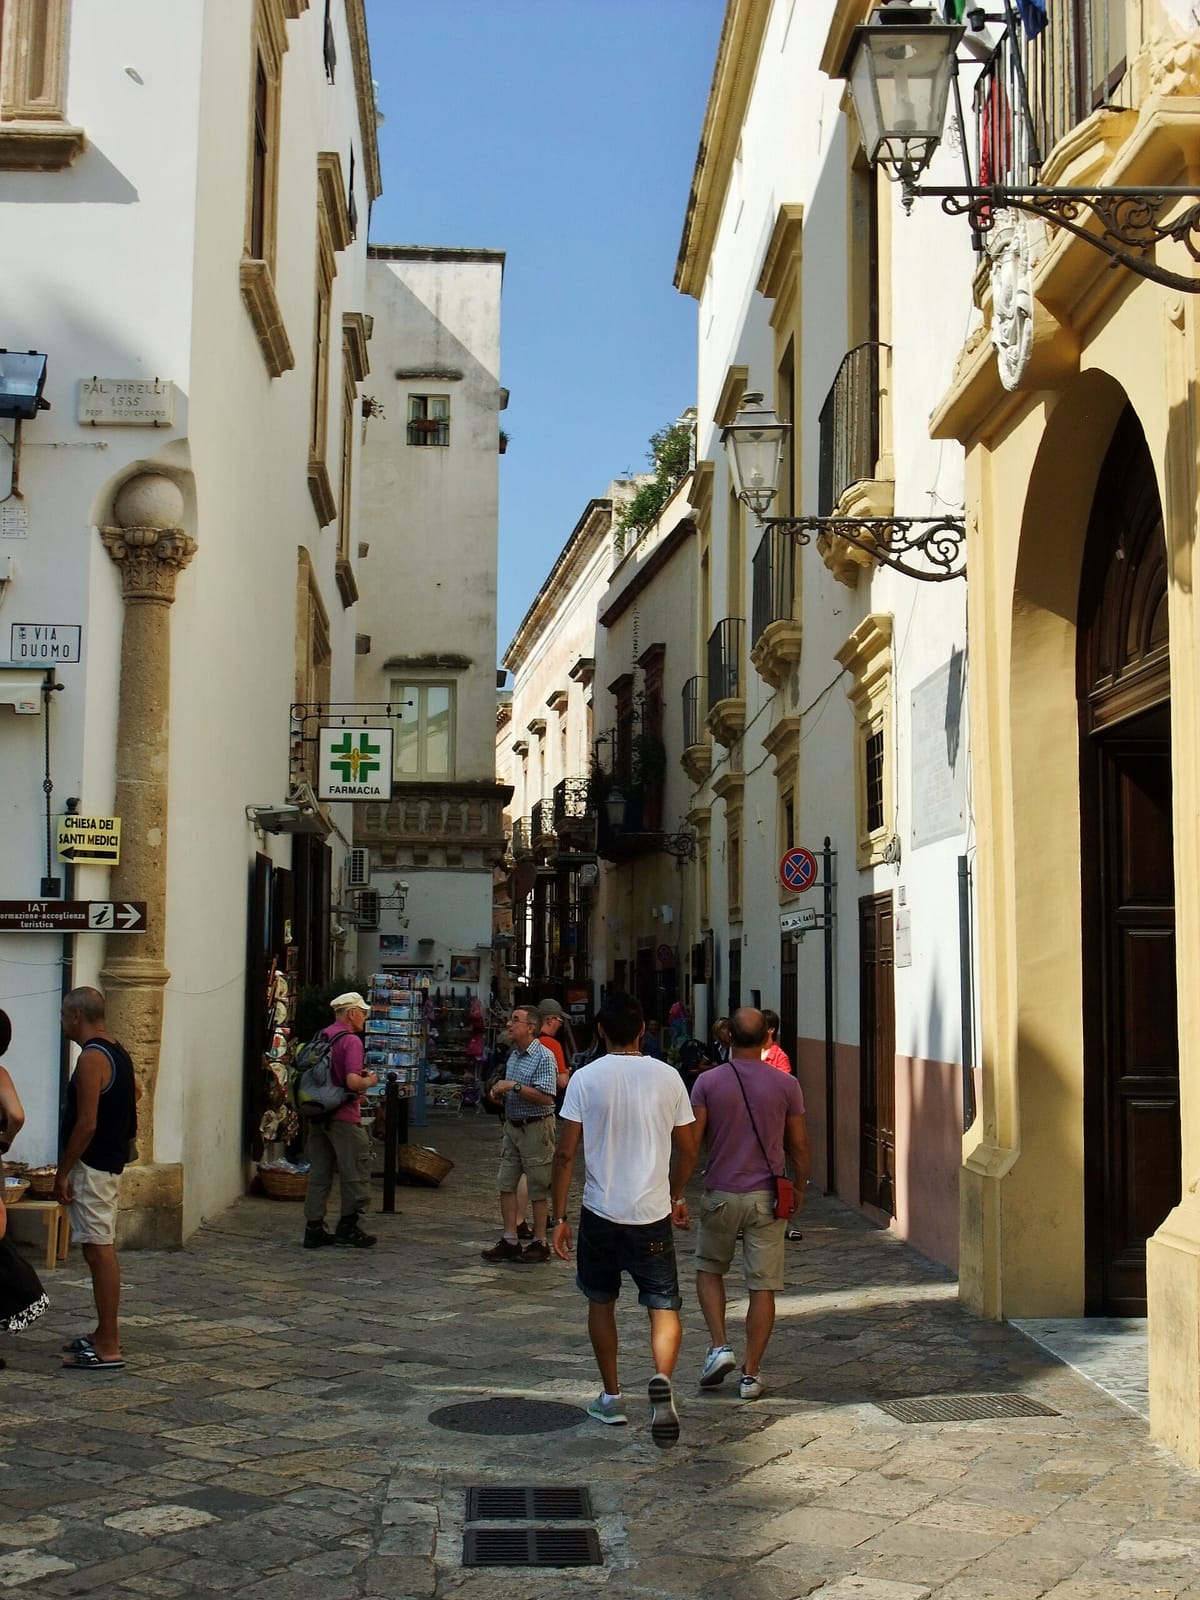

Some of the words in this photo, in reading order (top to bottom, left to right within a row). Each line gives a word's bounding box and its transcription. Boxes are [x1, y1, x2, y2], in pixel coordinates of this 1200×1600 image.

[115, 384, 167, 394] PIRELLI
[35, 627, 57, 640] VIA
[21, 644, 70, 657] DUOMO
[329, 785, 381, 795] FARMACIA
[64, 817, 97, 829] CHIESA
[98, 819, 114, 830] DEI
[58, 833, 86, 845] SANTI
[87, 834, 118, 847] MEDICI
[27, 903, 48, 912] IAT
[20, 920, 54, 929] turistica
